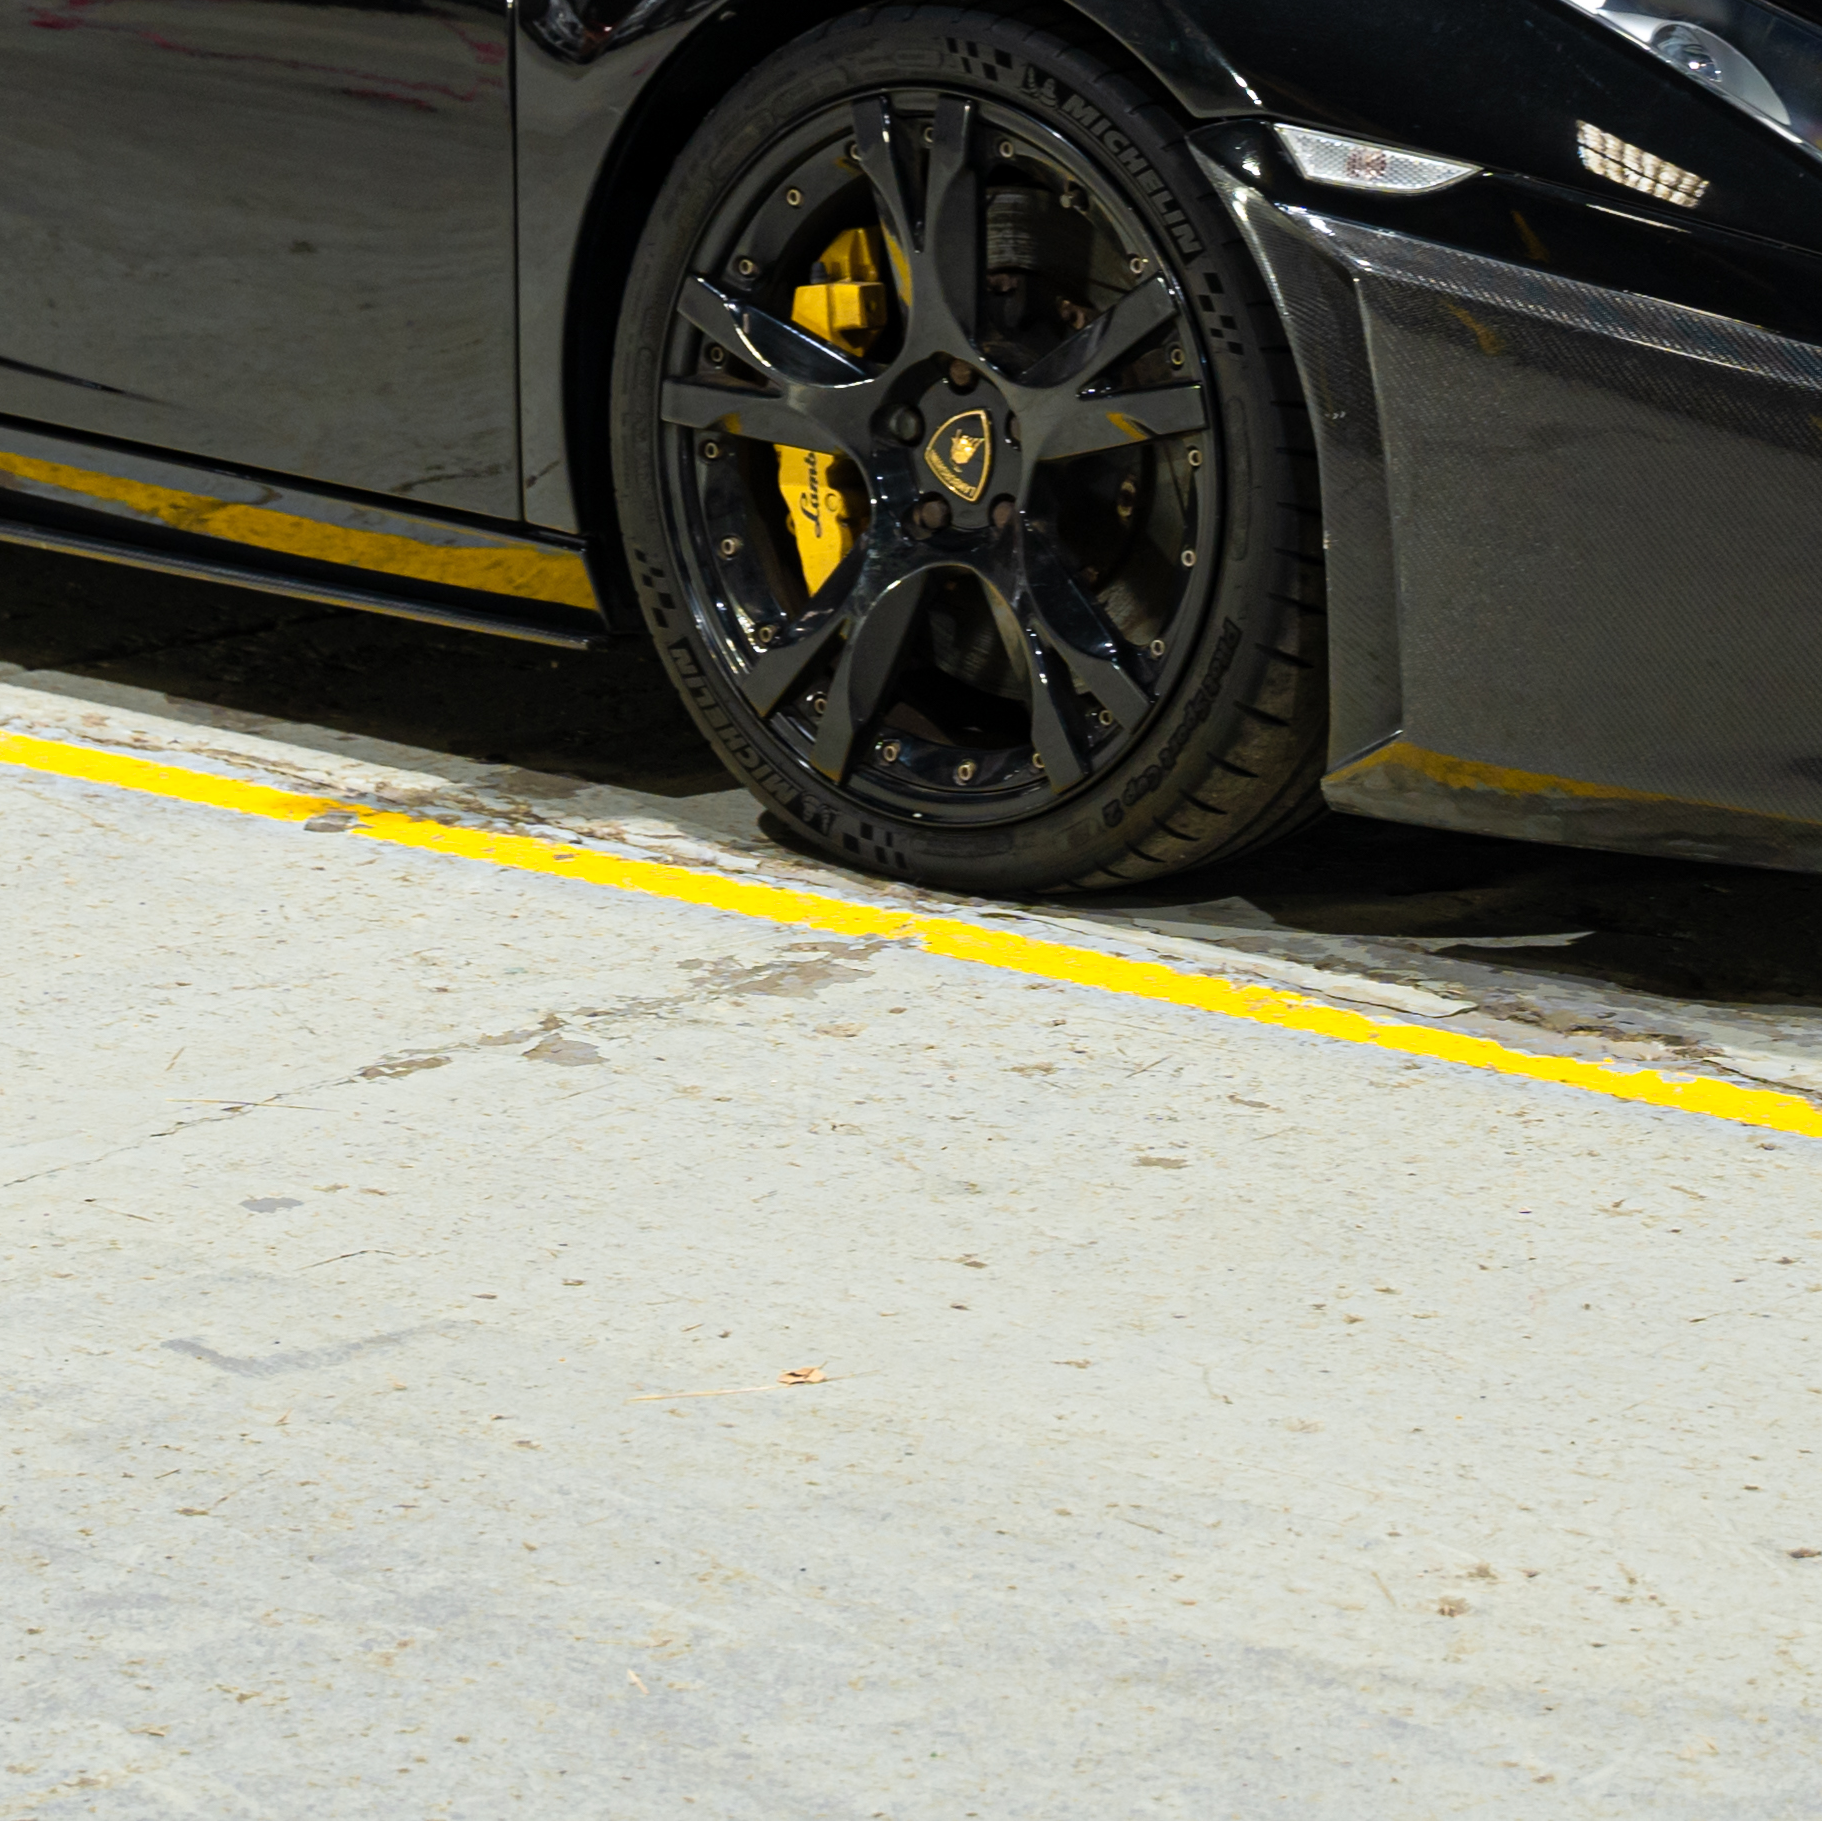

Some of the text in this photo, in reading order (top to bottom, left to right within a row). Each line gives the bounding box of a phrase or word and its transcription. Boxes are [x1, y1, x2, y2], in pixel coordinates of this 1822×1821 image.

[1061, 93, 1202, 254] MICHELIN
[1202, 616, 1243, 699] Pilot
[667, 646, 800, 806] MICHELIN
[1158, 687, 1214, 772] Sport
[1102, 798, 1125, 828] 2
